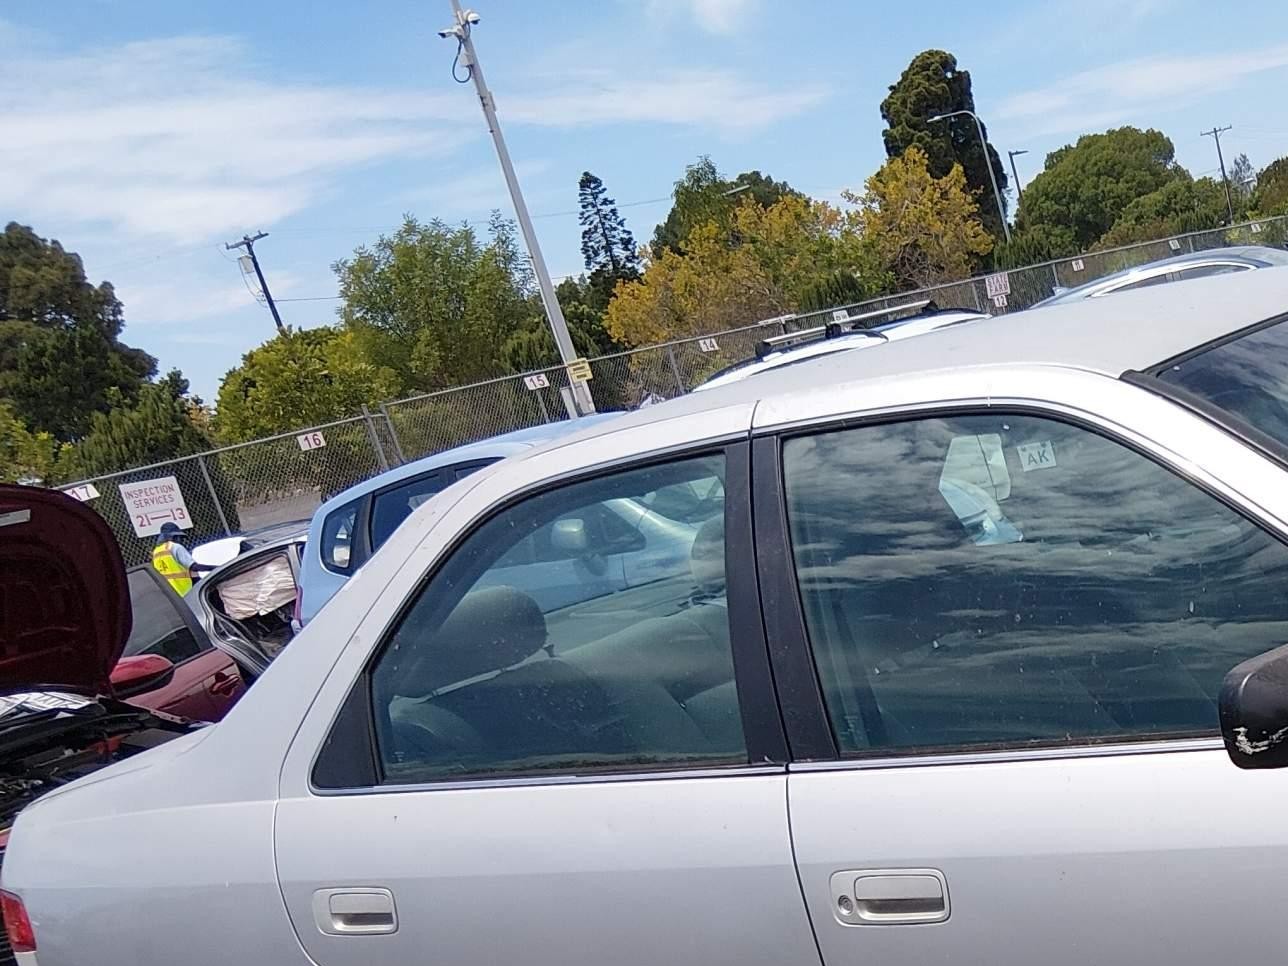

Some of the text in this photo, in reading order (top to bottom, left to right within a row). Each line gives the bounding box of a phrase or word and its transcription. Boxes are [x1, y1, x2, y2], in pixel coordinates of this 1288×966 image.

[996, 295, 1006, 306] 12
[703, 340, 716, 351] 14
[530, 375, 546, 388] 15
[304, 433, 322, 449] 16
[1028, 449, 1049, 465] AK
[71, 486, 92, 501] 17
[124, 484, 175, 499] INSPECTION
[133, 494, 174, 509] SERVICES
